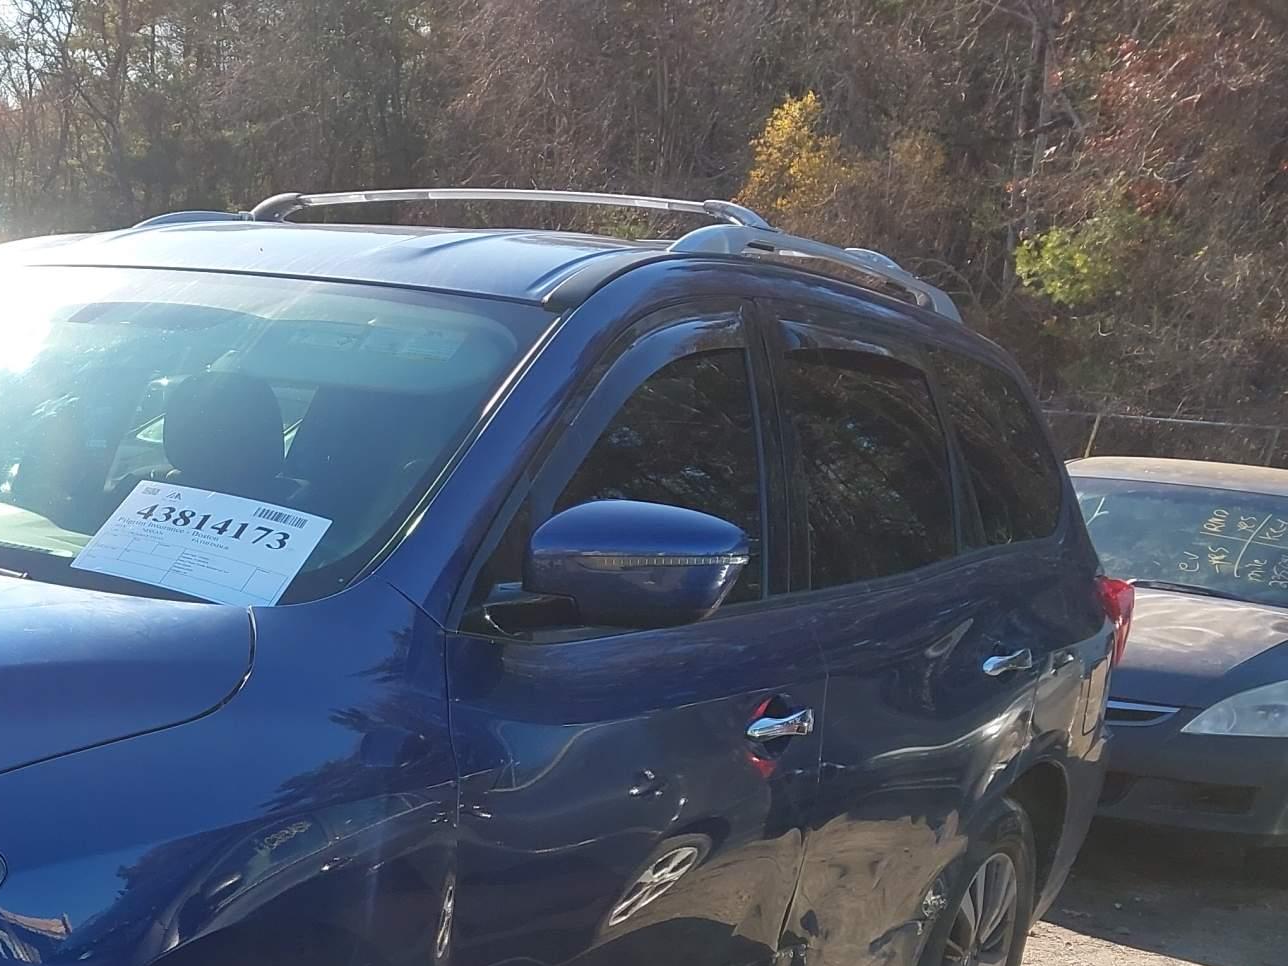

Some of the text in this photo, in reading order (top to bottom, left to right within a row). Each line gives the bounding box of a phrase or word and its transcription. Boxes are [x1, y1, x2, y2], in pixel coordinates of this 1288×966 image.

[136, 503, 291, 550] 43814173
[147, 521, 185, 534] Insurance
[192, 530, 219, 541] Boston
